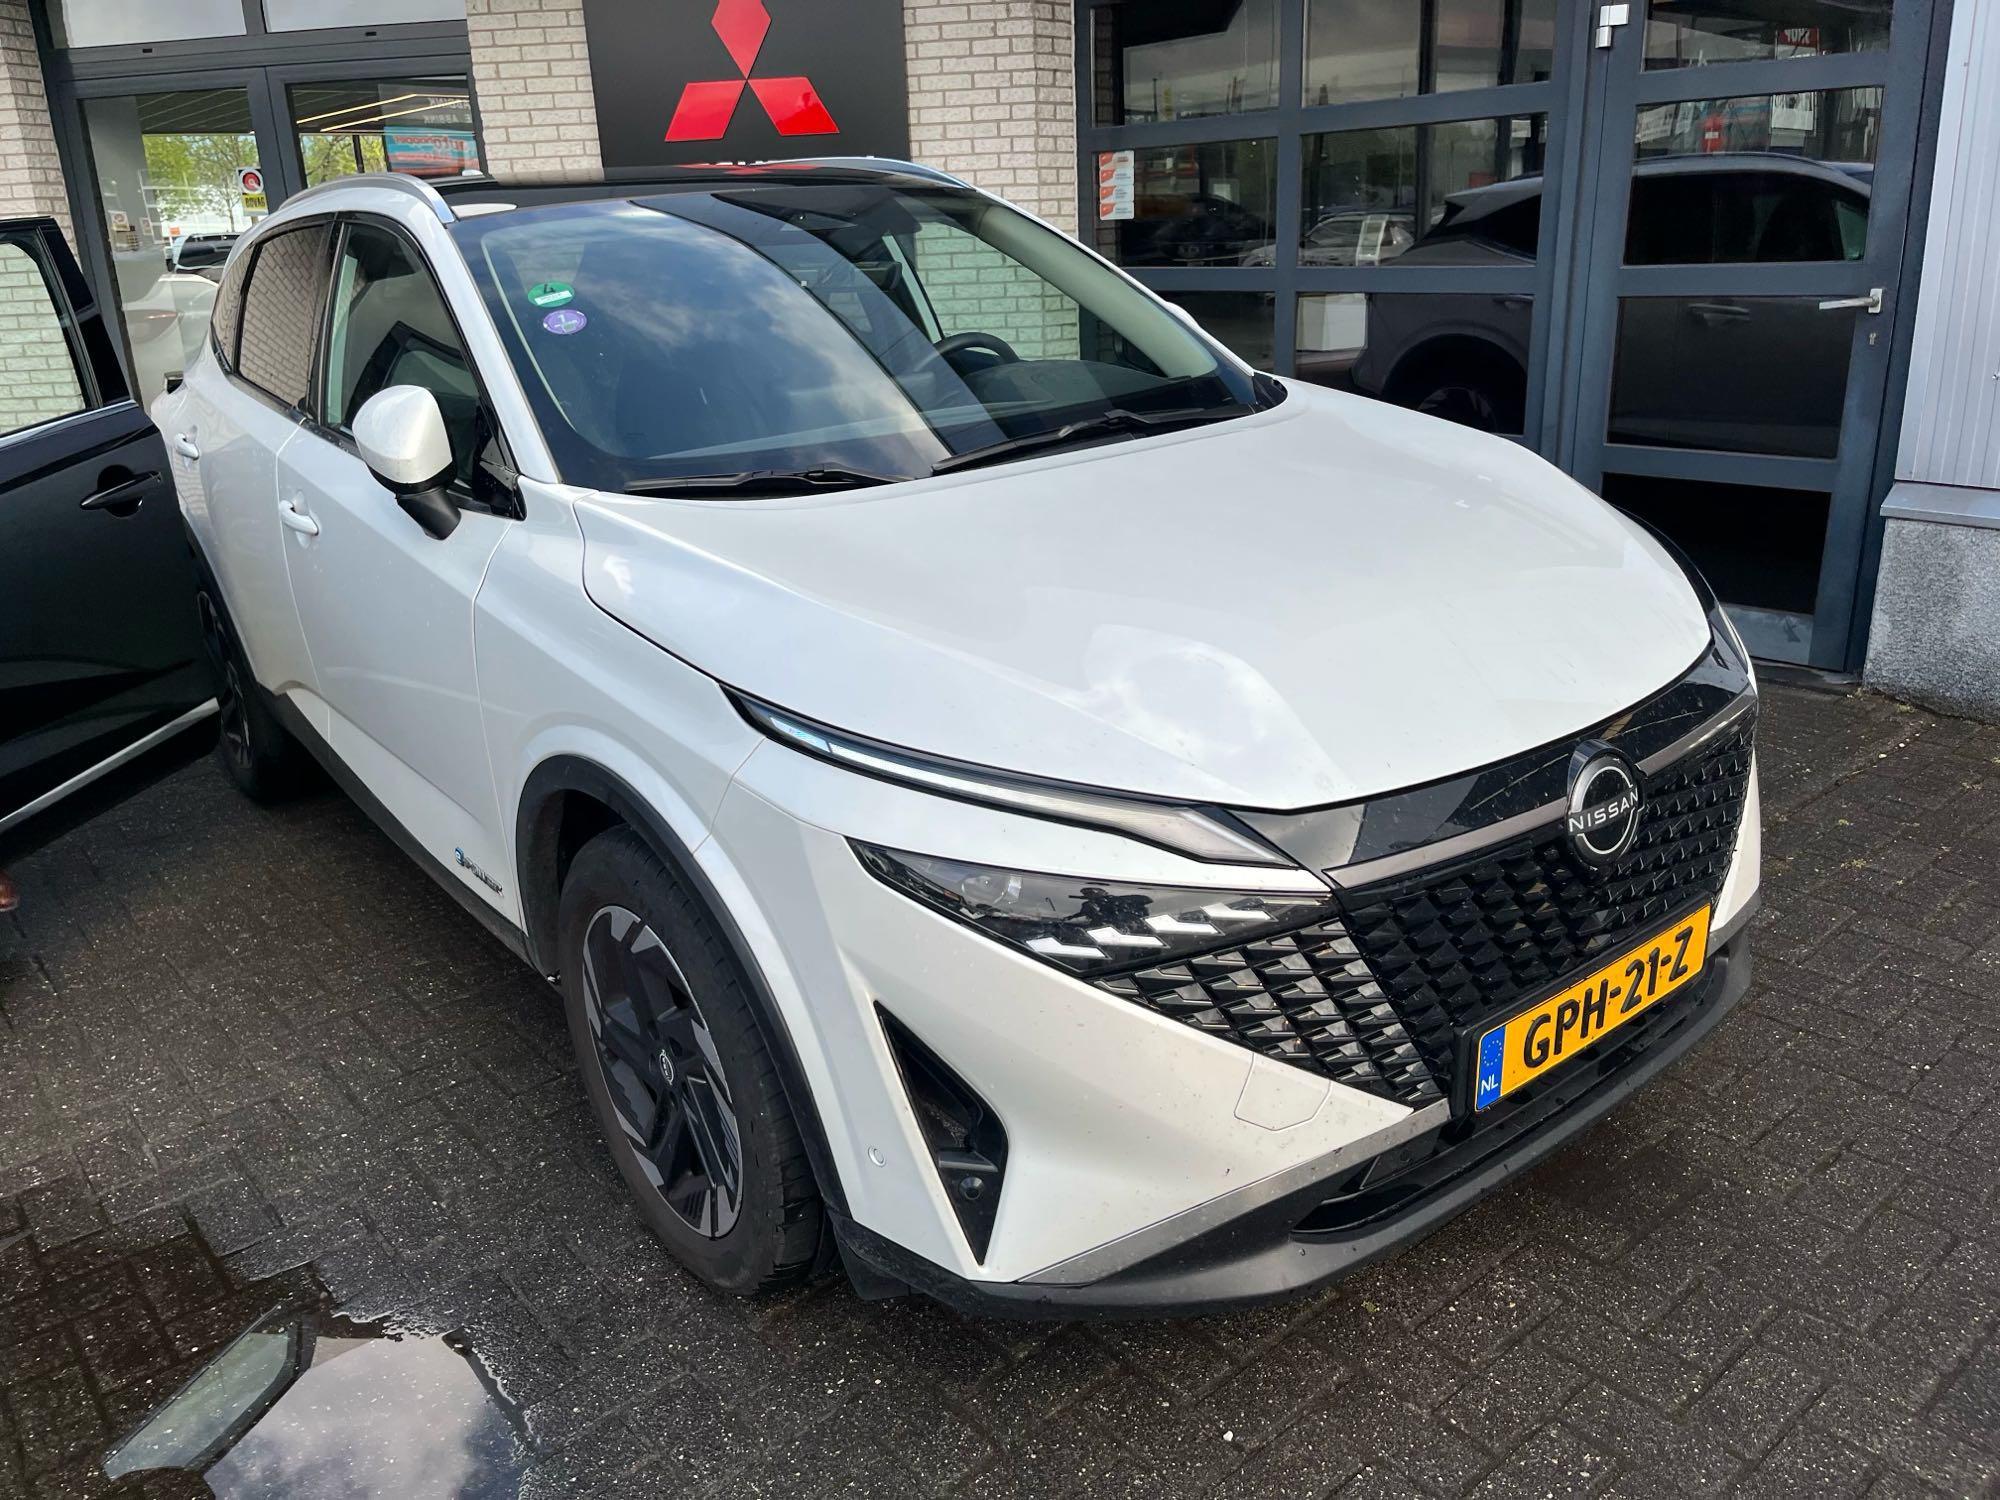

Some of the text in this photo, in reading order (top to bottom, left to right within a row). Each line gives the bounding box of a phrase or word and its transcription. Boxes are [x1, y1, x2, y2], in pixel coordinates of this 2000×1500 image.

[1568, 787, 1639, 832] NISSAN
[1523, 925, 1694, 1068] GPH-21-Z
[1480, 1073, 1499, 1096] NL
